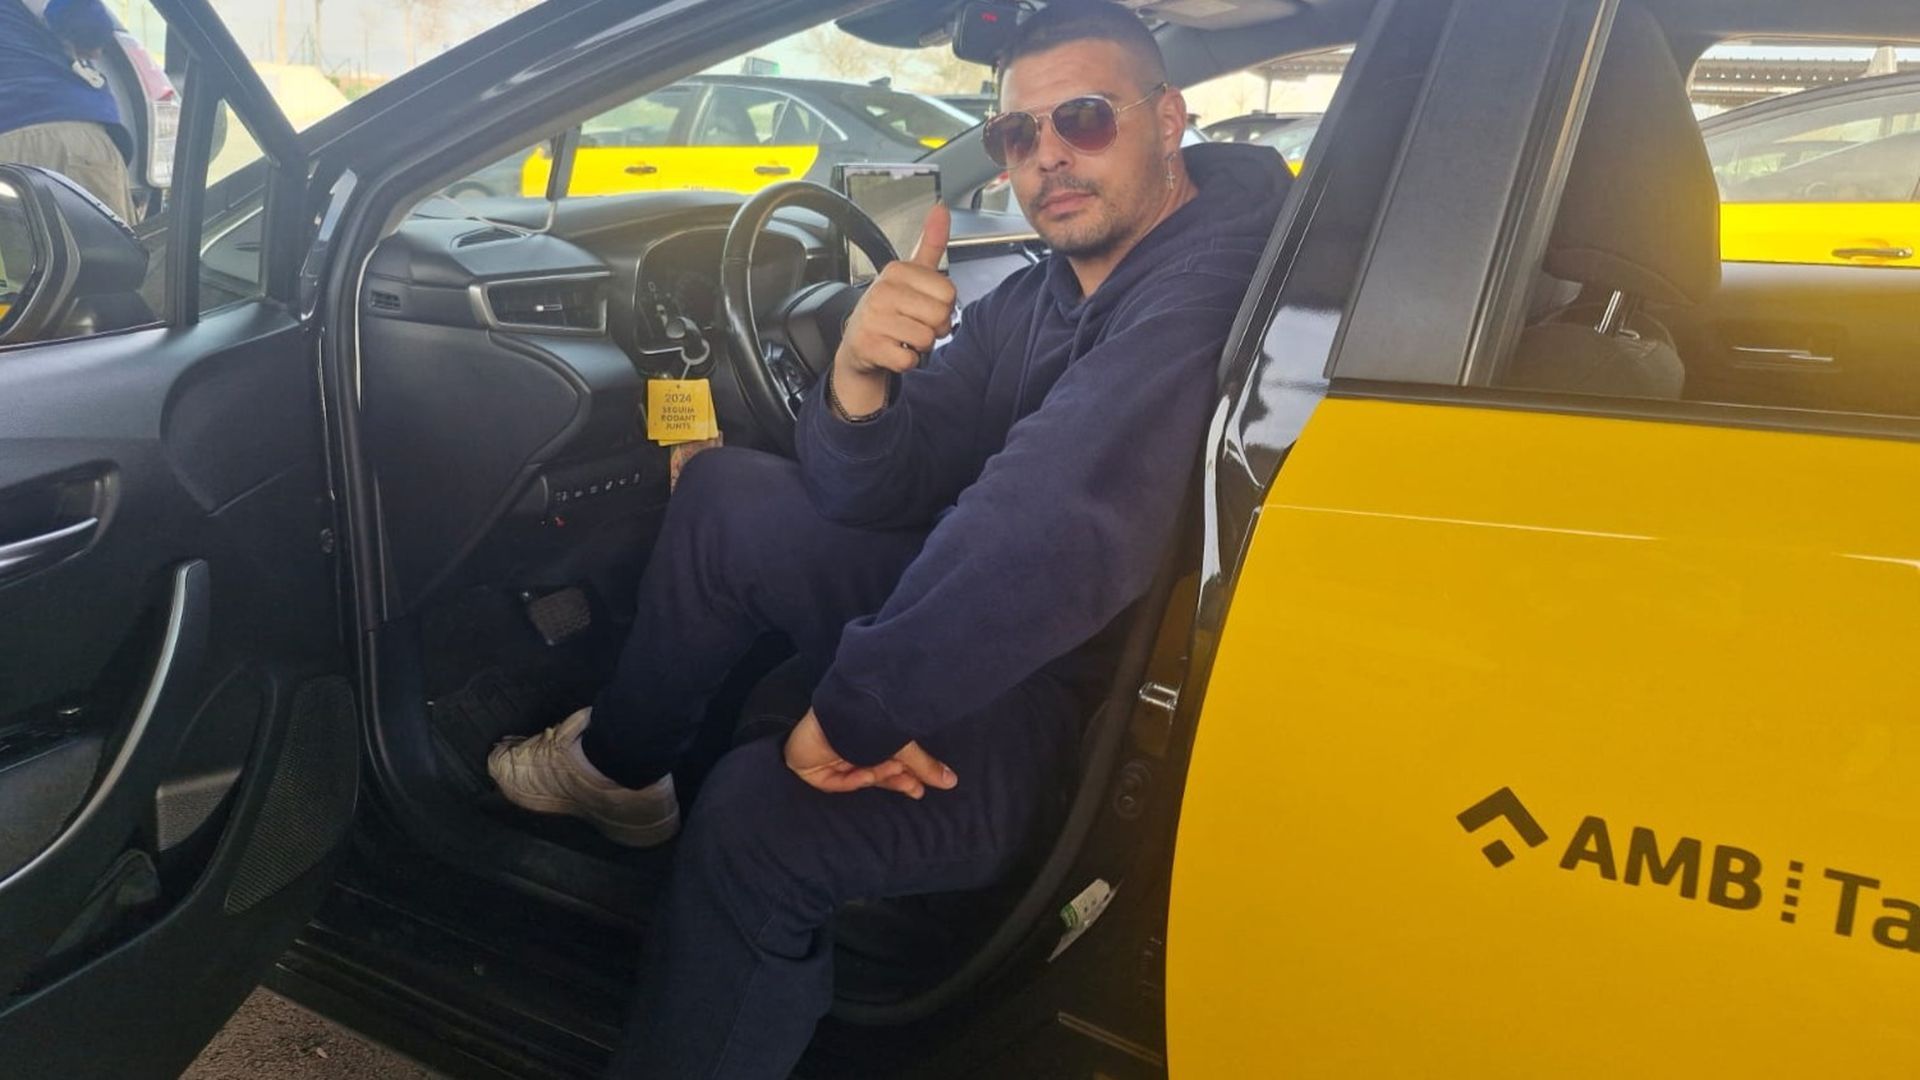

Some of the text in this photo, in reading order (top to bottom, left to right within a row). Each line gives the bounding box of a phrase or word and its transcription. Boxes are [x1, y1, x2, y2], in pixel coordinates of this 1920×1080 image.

[664, 393, 692, 403] 2024
[662, 406, 695, 414] SEGUIM
[661, 414, 696, 423] RODANT
[666, 422, 692, 431] JUNTS
[1559, 815, 1763, 911] AMB
